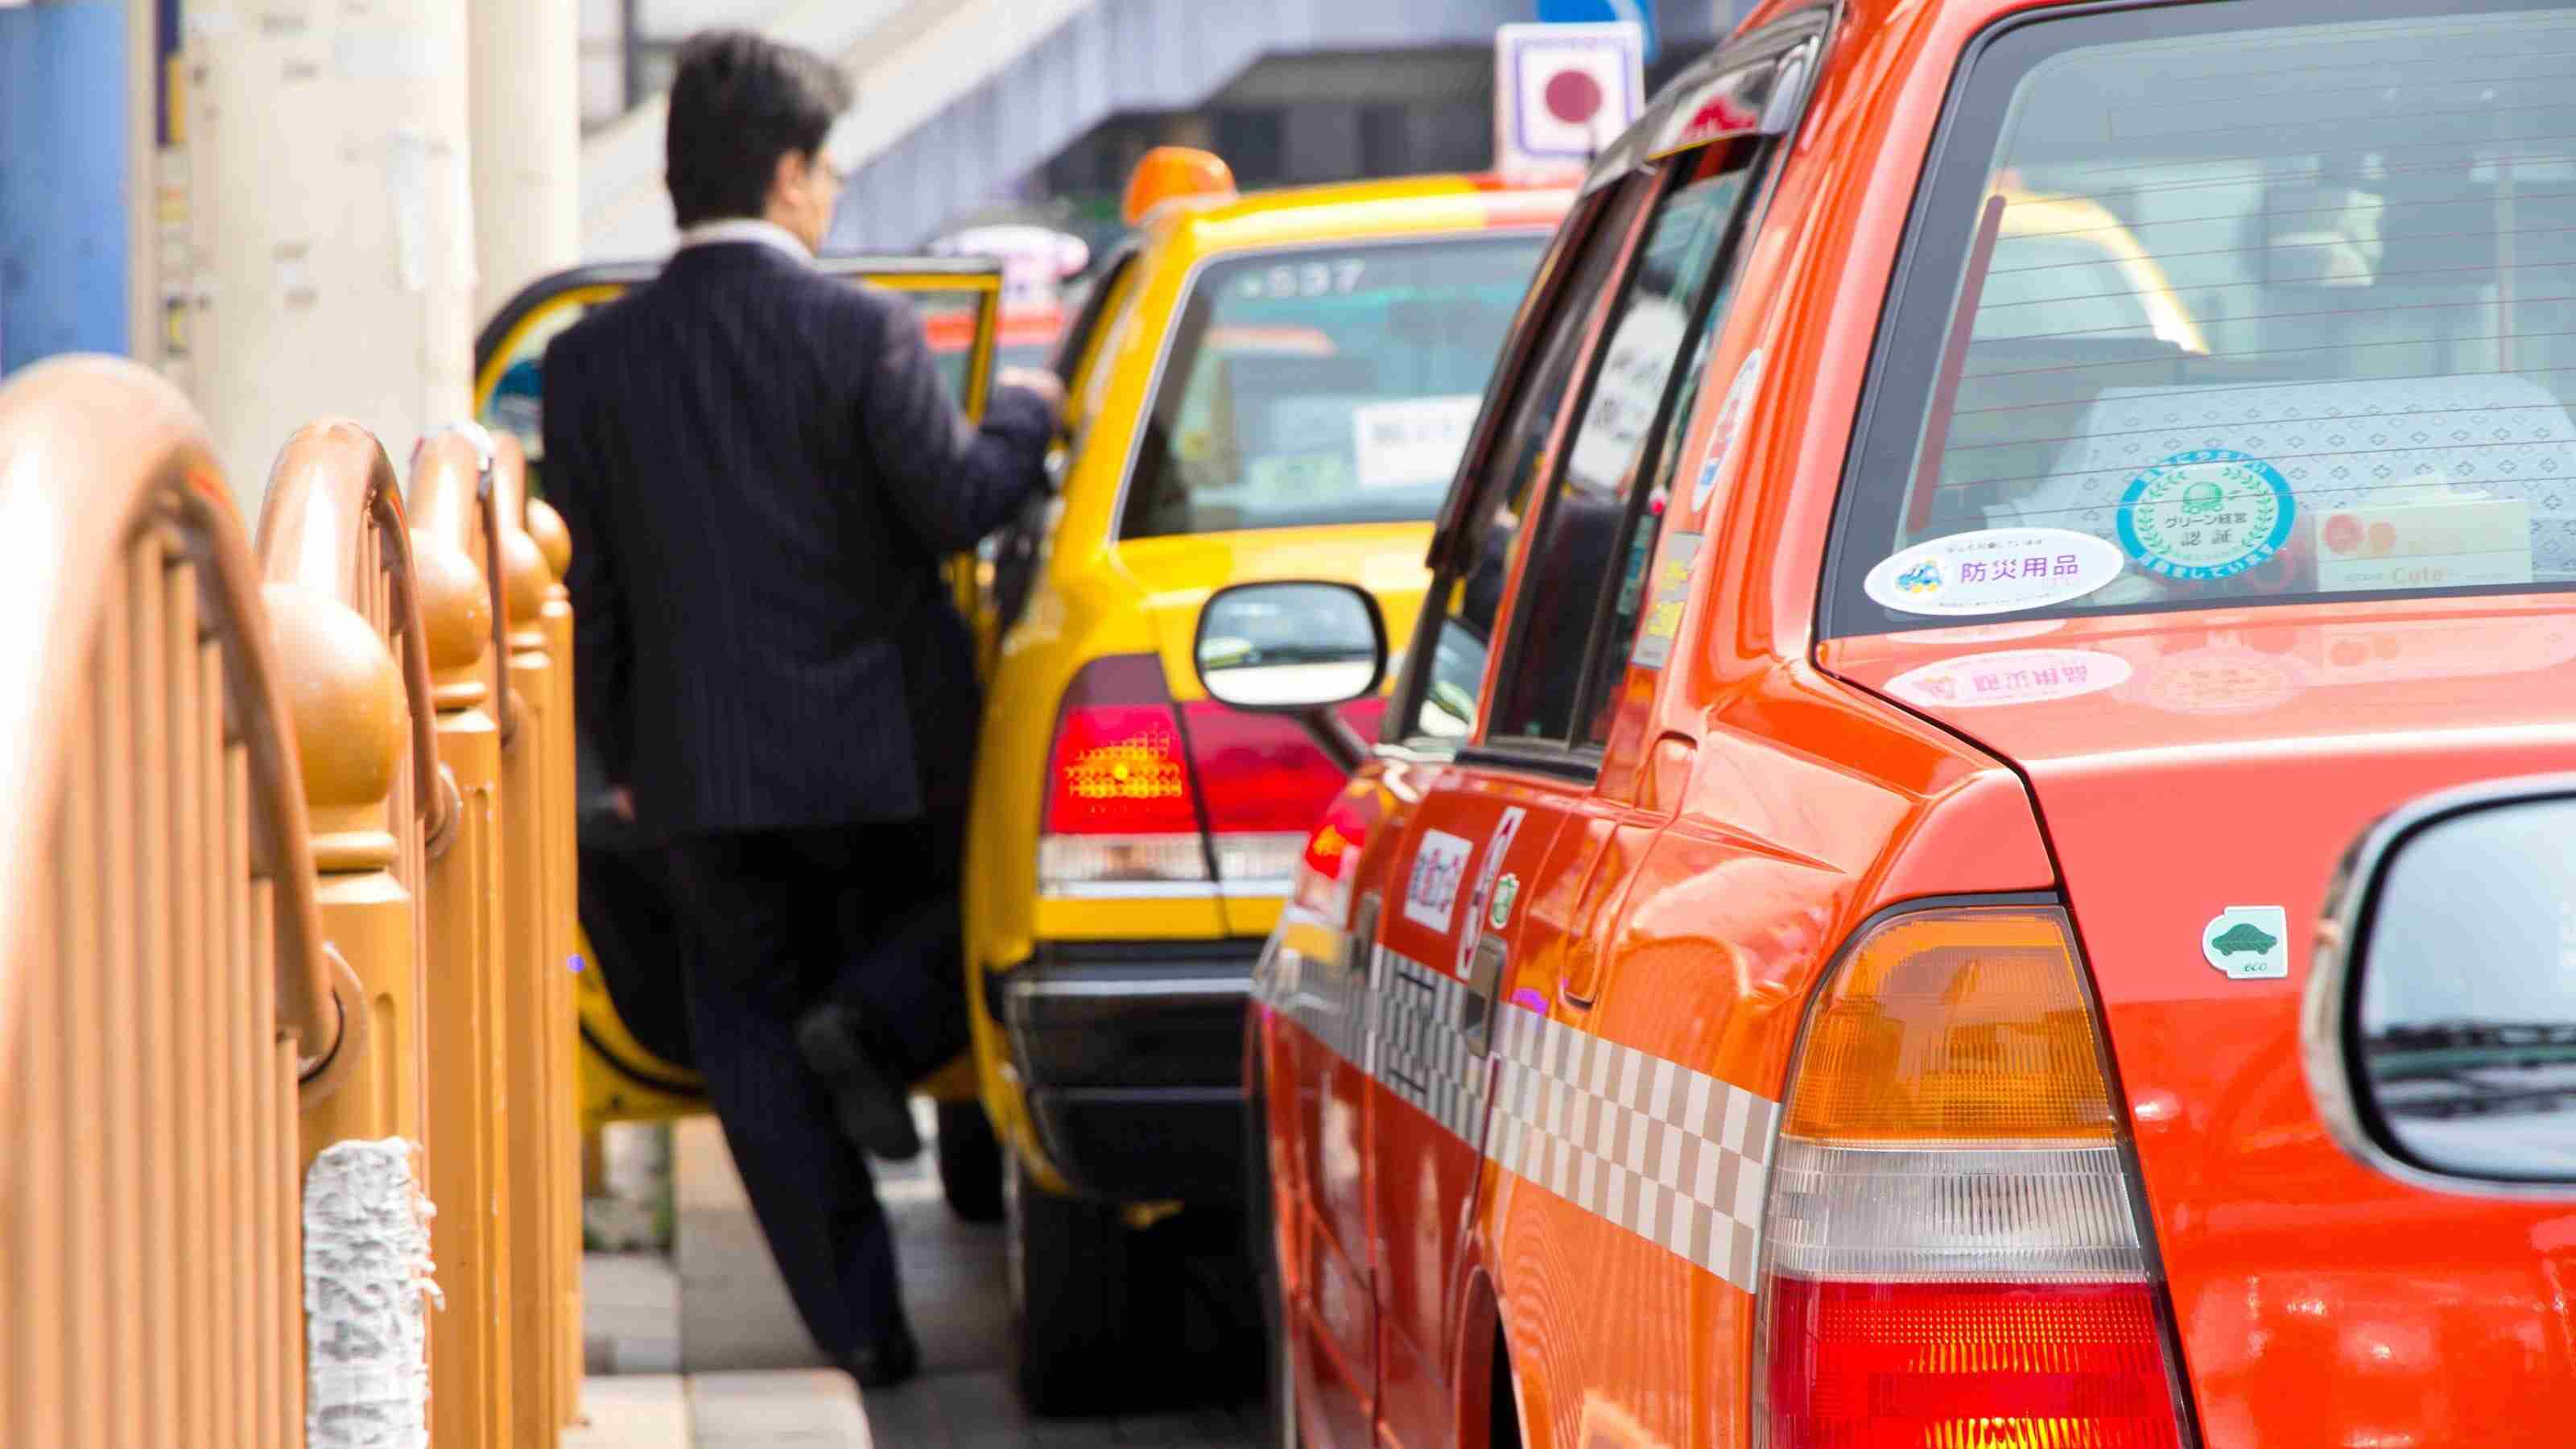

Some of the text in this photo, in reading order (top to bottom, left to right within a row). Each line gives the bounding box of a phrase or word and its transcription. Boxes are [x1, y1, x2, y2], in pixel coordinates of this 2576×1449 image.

[1959, 554, 2079, 584] 防災用品
[2244, 963, 2268, 972] eco
